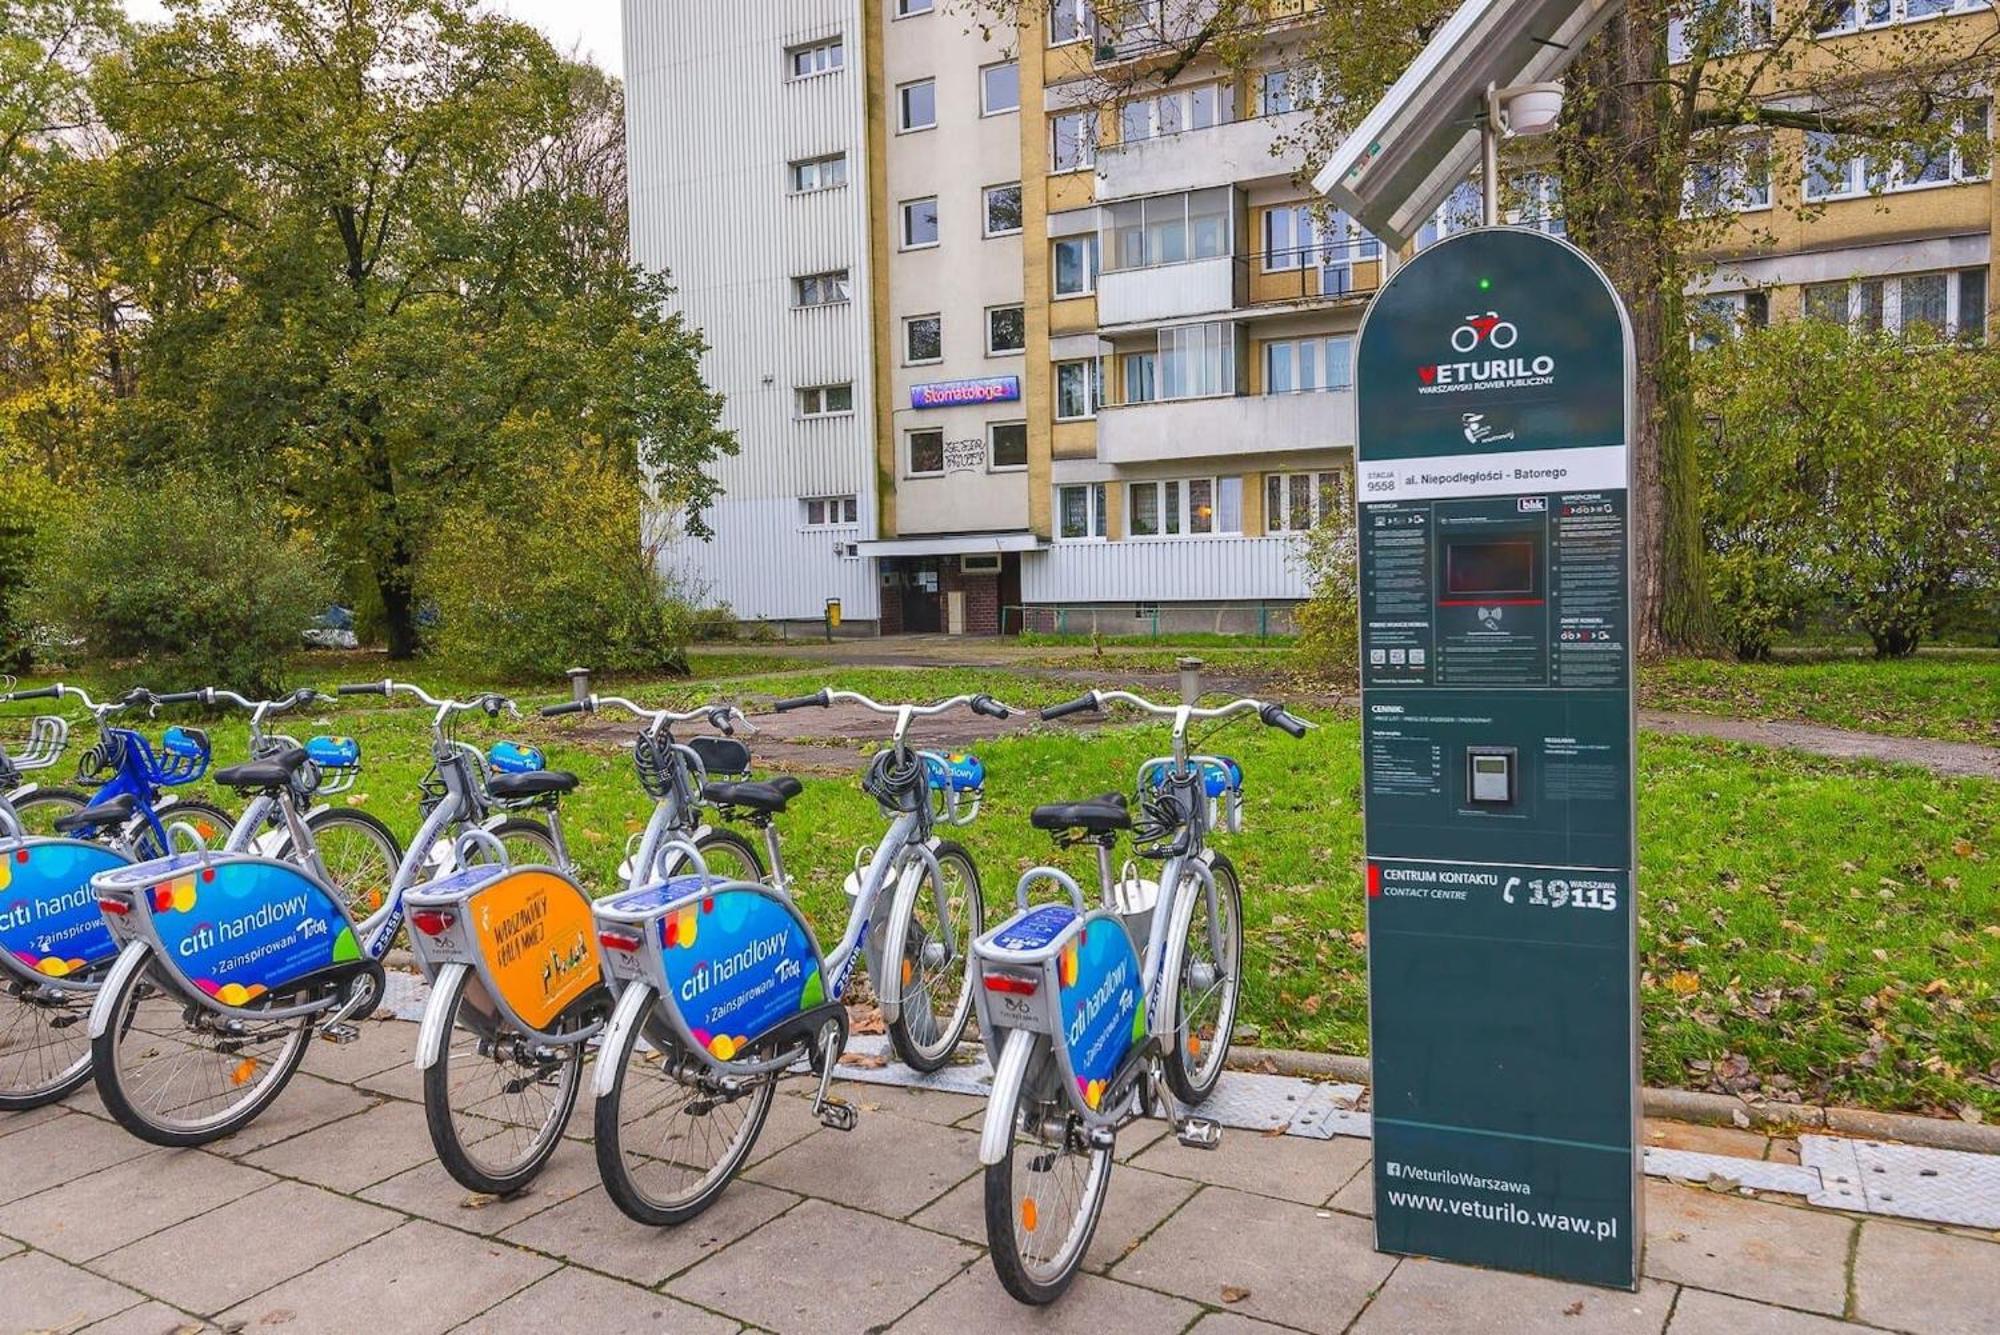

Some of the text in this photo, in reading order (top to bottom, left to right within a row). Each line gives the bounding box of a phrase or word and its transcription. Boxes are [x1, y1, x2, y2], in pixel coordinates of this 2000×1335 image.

[1417, 355, 1554, 384] VETURILO
[1418, 376, 1554, 394] WARSZAWSKI ROWER PUBLICZNY
[1368, 481, 1395, 491] 9558
[1405, 475, 1417, 485] al.
[1421, 470, 1503, 485] Niepodległości
[1514, 468, 1567, 480] Batorego
[1384, 869, 1498, 886] CENTRUM KONTAKTU
[1569, 880, 1617, 890] WARSZAWA
[35, 883, 98, 919] handlo
[1384, 886, 1468, 900] CONTACT CENTRE
[37, 917, 106, 948] Zainspirowa
[179, 892, 308, 957] citi handlowy
[218, 931, 297, 974] Zainspirowani
[681, 929, 789, 1001] citi handlowy
[711, 976, 776, 1023] Zainspirowani
[1388, 1190, 1617, 1241] www.veturilo.waw.pl
